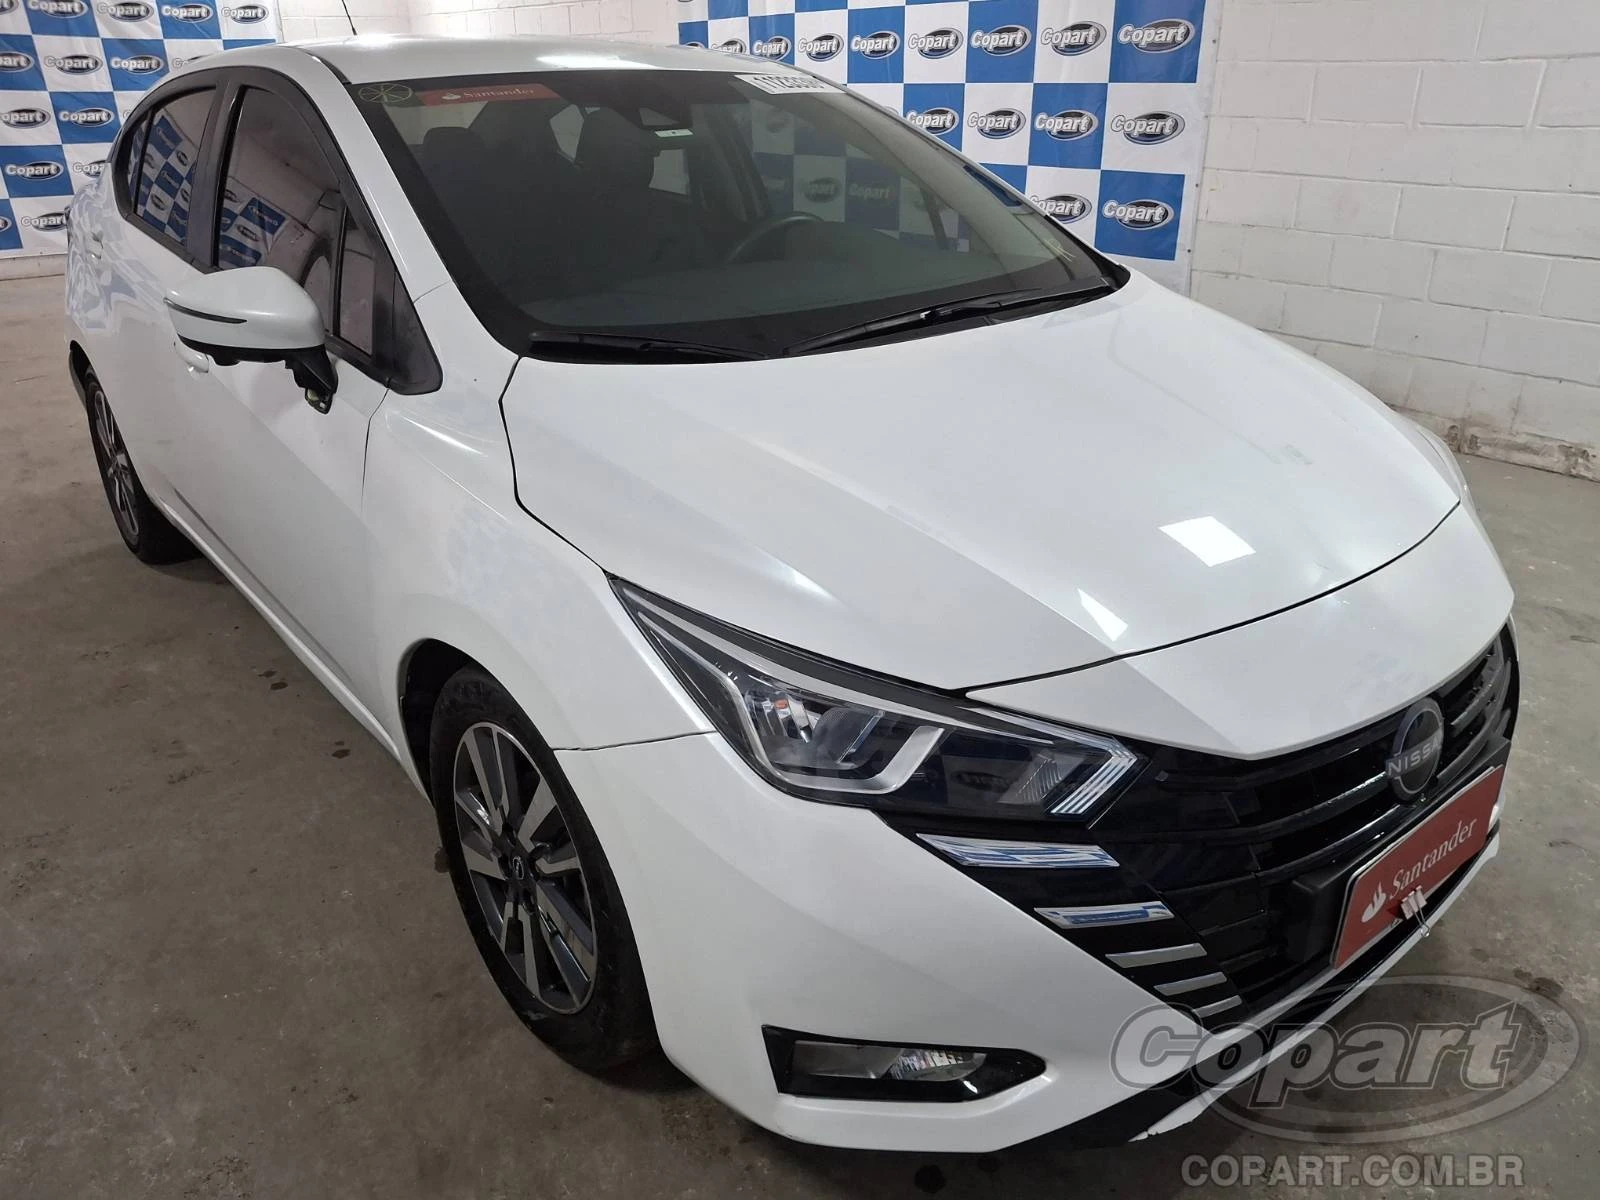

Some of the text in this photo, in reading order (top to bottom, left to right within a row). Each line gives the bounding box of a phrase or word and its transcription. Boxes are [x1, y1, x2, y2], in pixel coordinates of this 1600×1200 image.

[98, 4, 148, 16] Copart
[163, 6, 208, 17] Copart
[223, 8, 264, 18] Copart
[852, 35, 895, 51] Copart
[908, 33, 956, 50] Copart
[971, 30, 1025, 47] Copart
[1041, 28, 1097, 47] Copart
[1118, 24, 1187, 47] Copart
[753, 40, 785, 57] Copart
[798, 38, 836, 54] Copart
[45, 57, 96, 69] Copart
[111, 58, 159, 70] Copart
[0, 111, 44, 124] opart
[60, 111, 108, 124] Copart
[968, 112, 1019, 131] Copart
[1035, 114, 1090, 133] Copart
[1111, 115, 1175, 136] Copart
[5, 164, 57, 176] Copart
[1103, 200, 1166, 224] Copart
[1389, 818, 1478, 900] Santander
